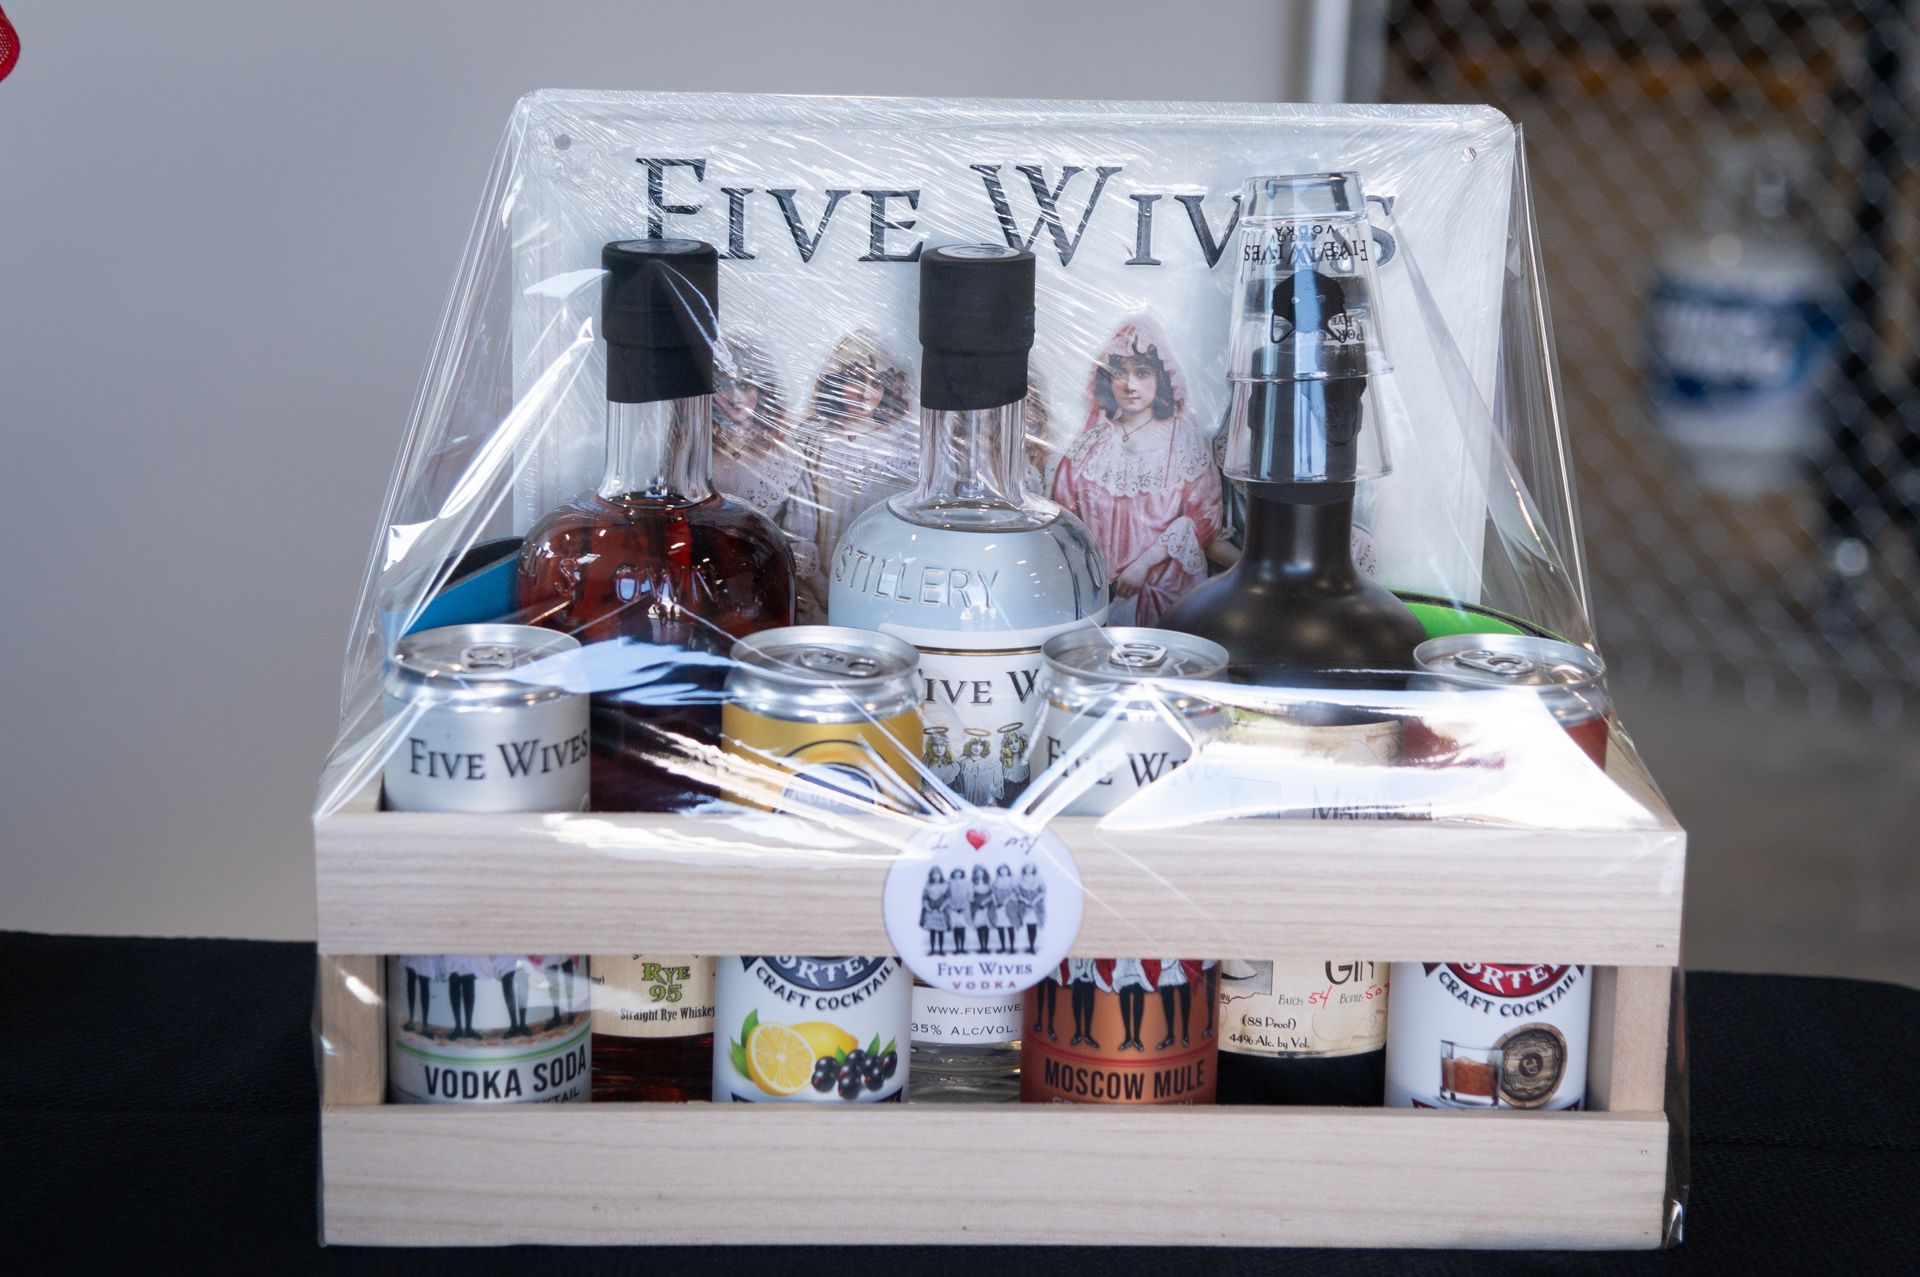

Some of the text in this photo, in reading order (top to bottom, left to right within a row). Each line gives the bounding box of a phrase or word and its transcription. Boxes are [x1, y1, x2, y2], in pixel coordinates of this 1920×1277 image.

[636, 158, 923, 264] FIVE
[917, 668, 992, 704] IVE
[409, 727, 588, 781] FIVE WIVES
[641, 962, 691, 985] RYE
[937, 961, 1033, 977] FIVE WIVES
[649, 984, 683, 1003] 95
[756, 965, 894, 1011] CRAFT COCKTAIL
[952, 981, 1017, 990] VODKA
[1308, 985, 1333, 1009] 54
[1438, 971, 1577, 1017] CRAFT COCKTAIL
[620, 1008, 658, 1023] Straight
[661, 1008, 678, 1022] Rye
[1242, 1014, 1296, 1031] (88 Proof)
[911, 1022, 943, 1036] 35%
[1229, 1033, 1310, 1050] 44% Alc. by Vol.
[424, 1043, 587, 1100] VODKA SODA
[1044, 1057, 1205, 1100] MOSCOW MULE
